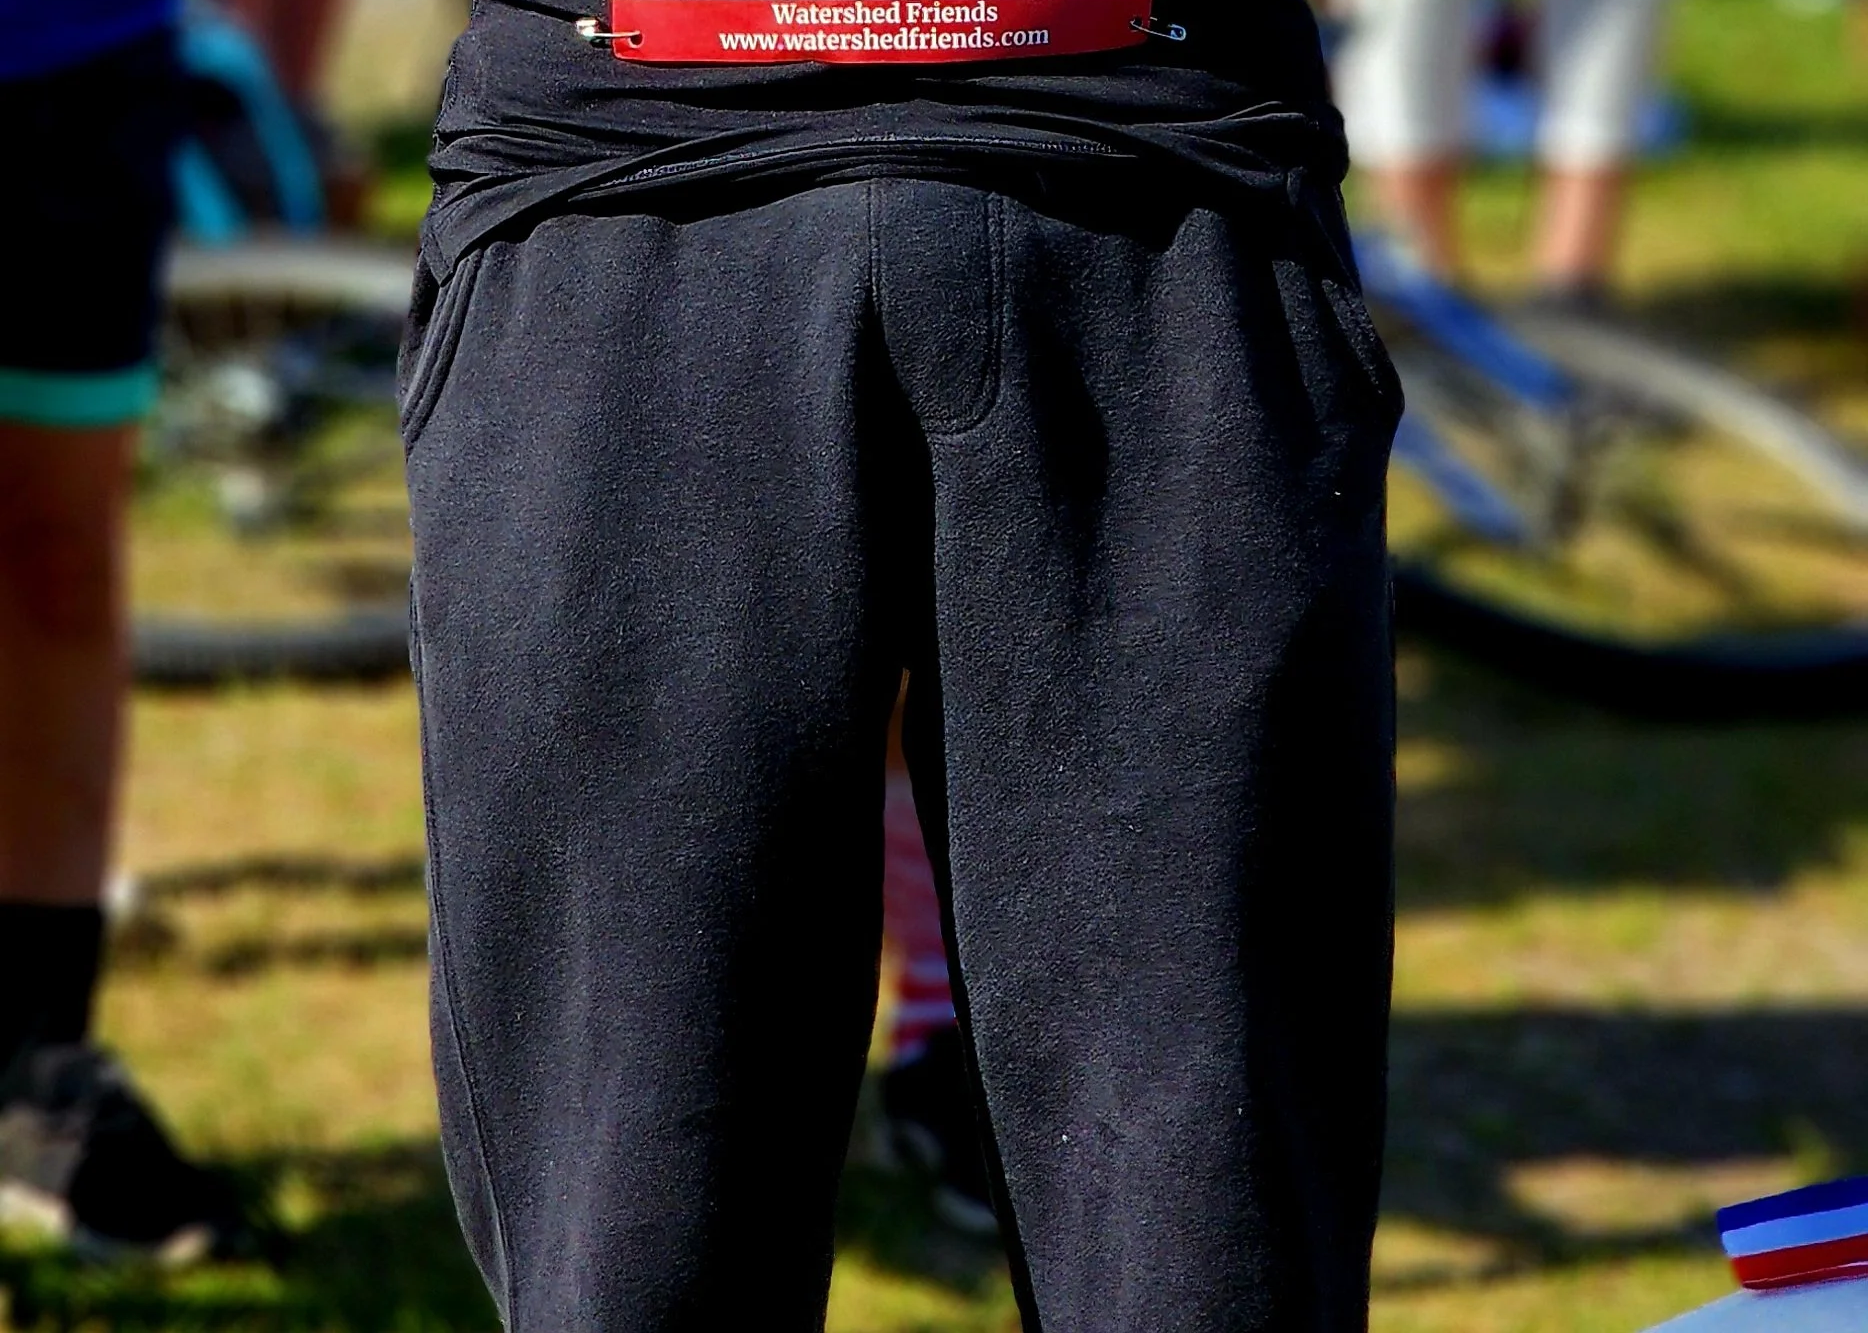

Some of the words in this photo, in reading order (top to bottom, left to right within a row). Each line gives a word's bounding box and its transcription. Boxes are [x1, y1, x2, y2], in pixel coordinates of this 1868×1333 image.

[771, 0, 901, 25] Watershed
[906, 0, 998, 24] Friends
[719, 26, 1050, 53] www.watershedfriends.com
